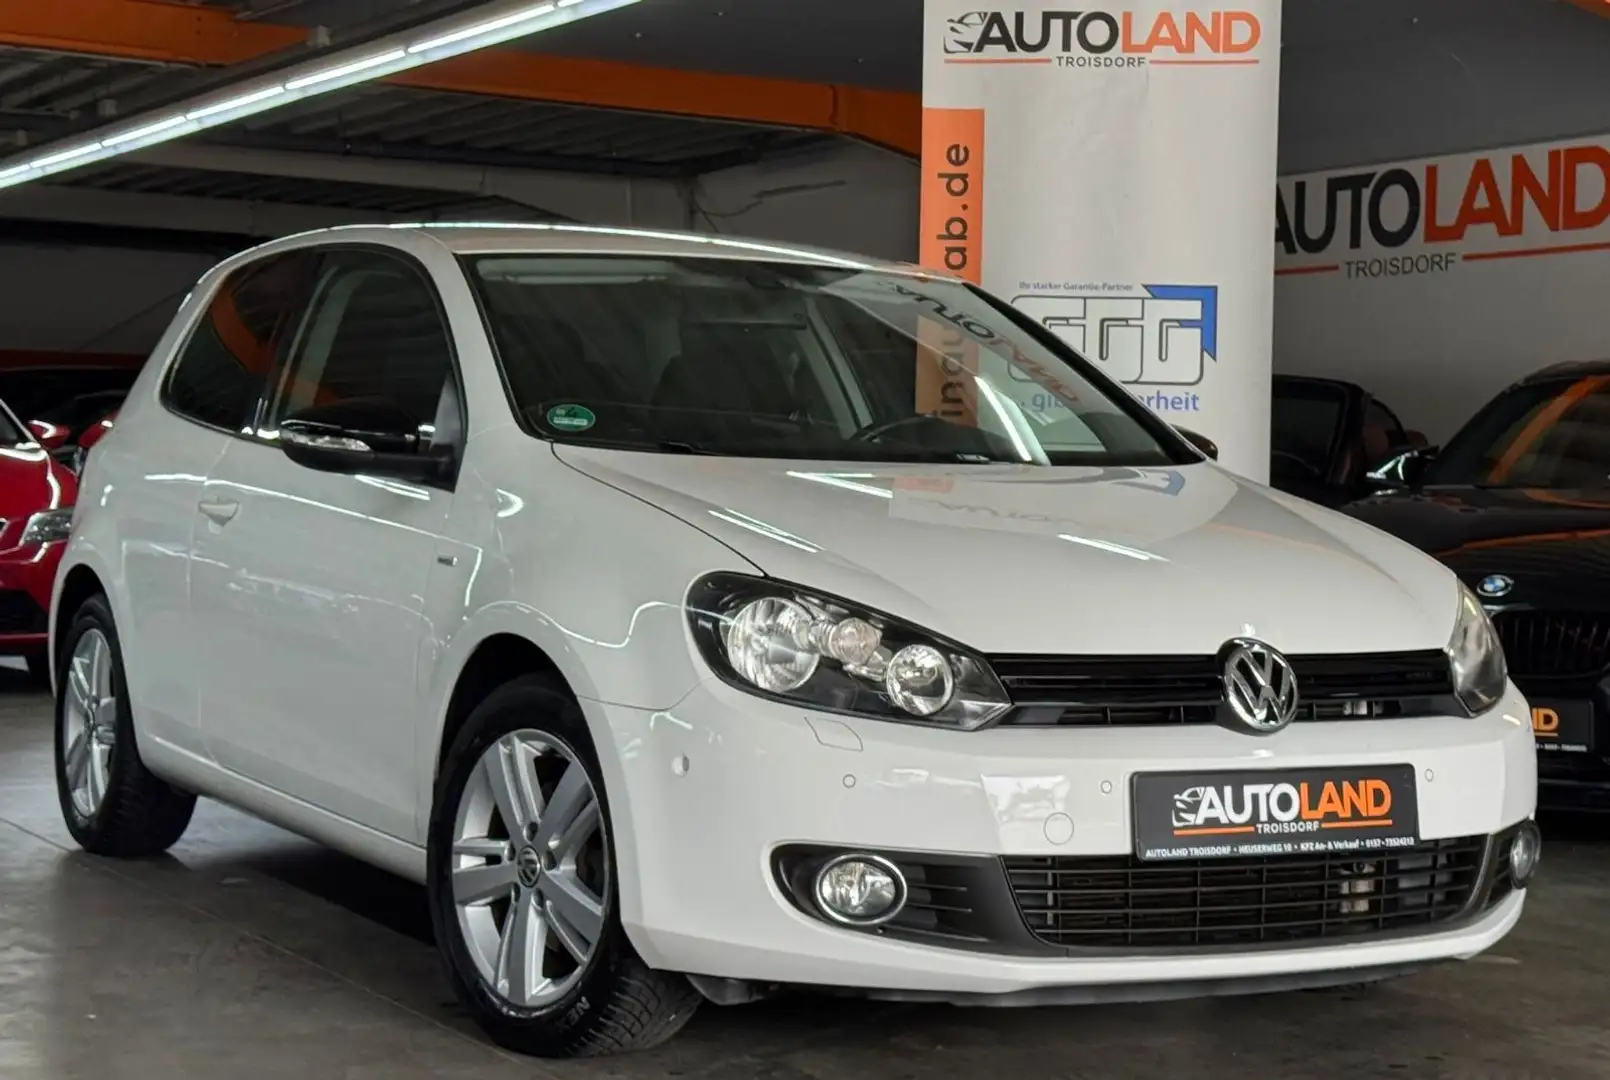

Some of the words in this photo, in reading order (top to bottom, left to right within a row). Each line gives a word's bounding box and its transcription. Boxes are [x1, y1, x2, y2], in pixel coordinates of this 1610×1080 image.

[973, 11, 1260, 54] AUTOLAND
[1056, 56, 1146, 68] TROISDORF
[1345, 252, 1457, 280] TROISDORF
[1195, 779, 1392, 826] AUTOLAND
[1256, 820, 1320, 834] TROISDORF
